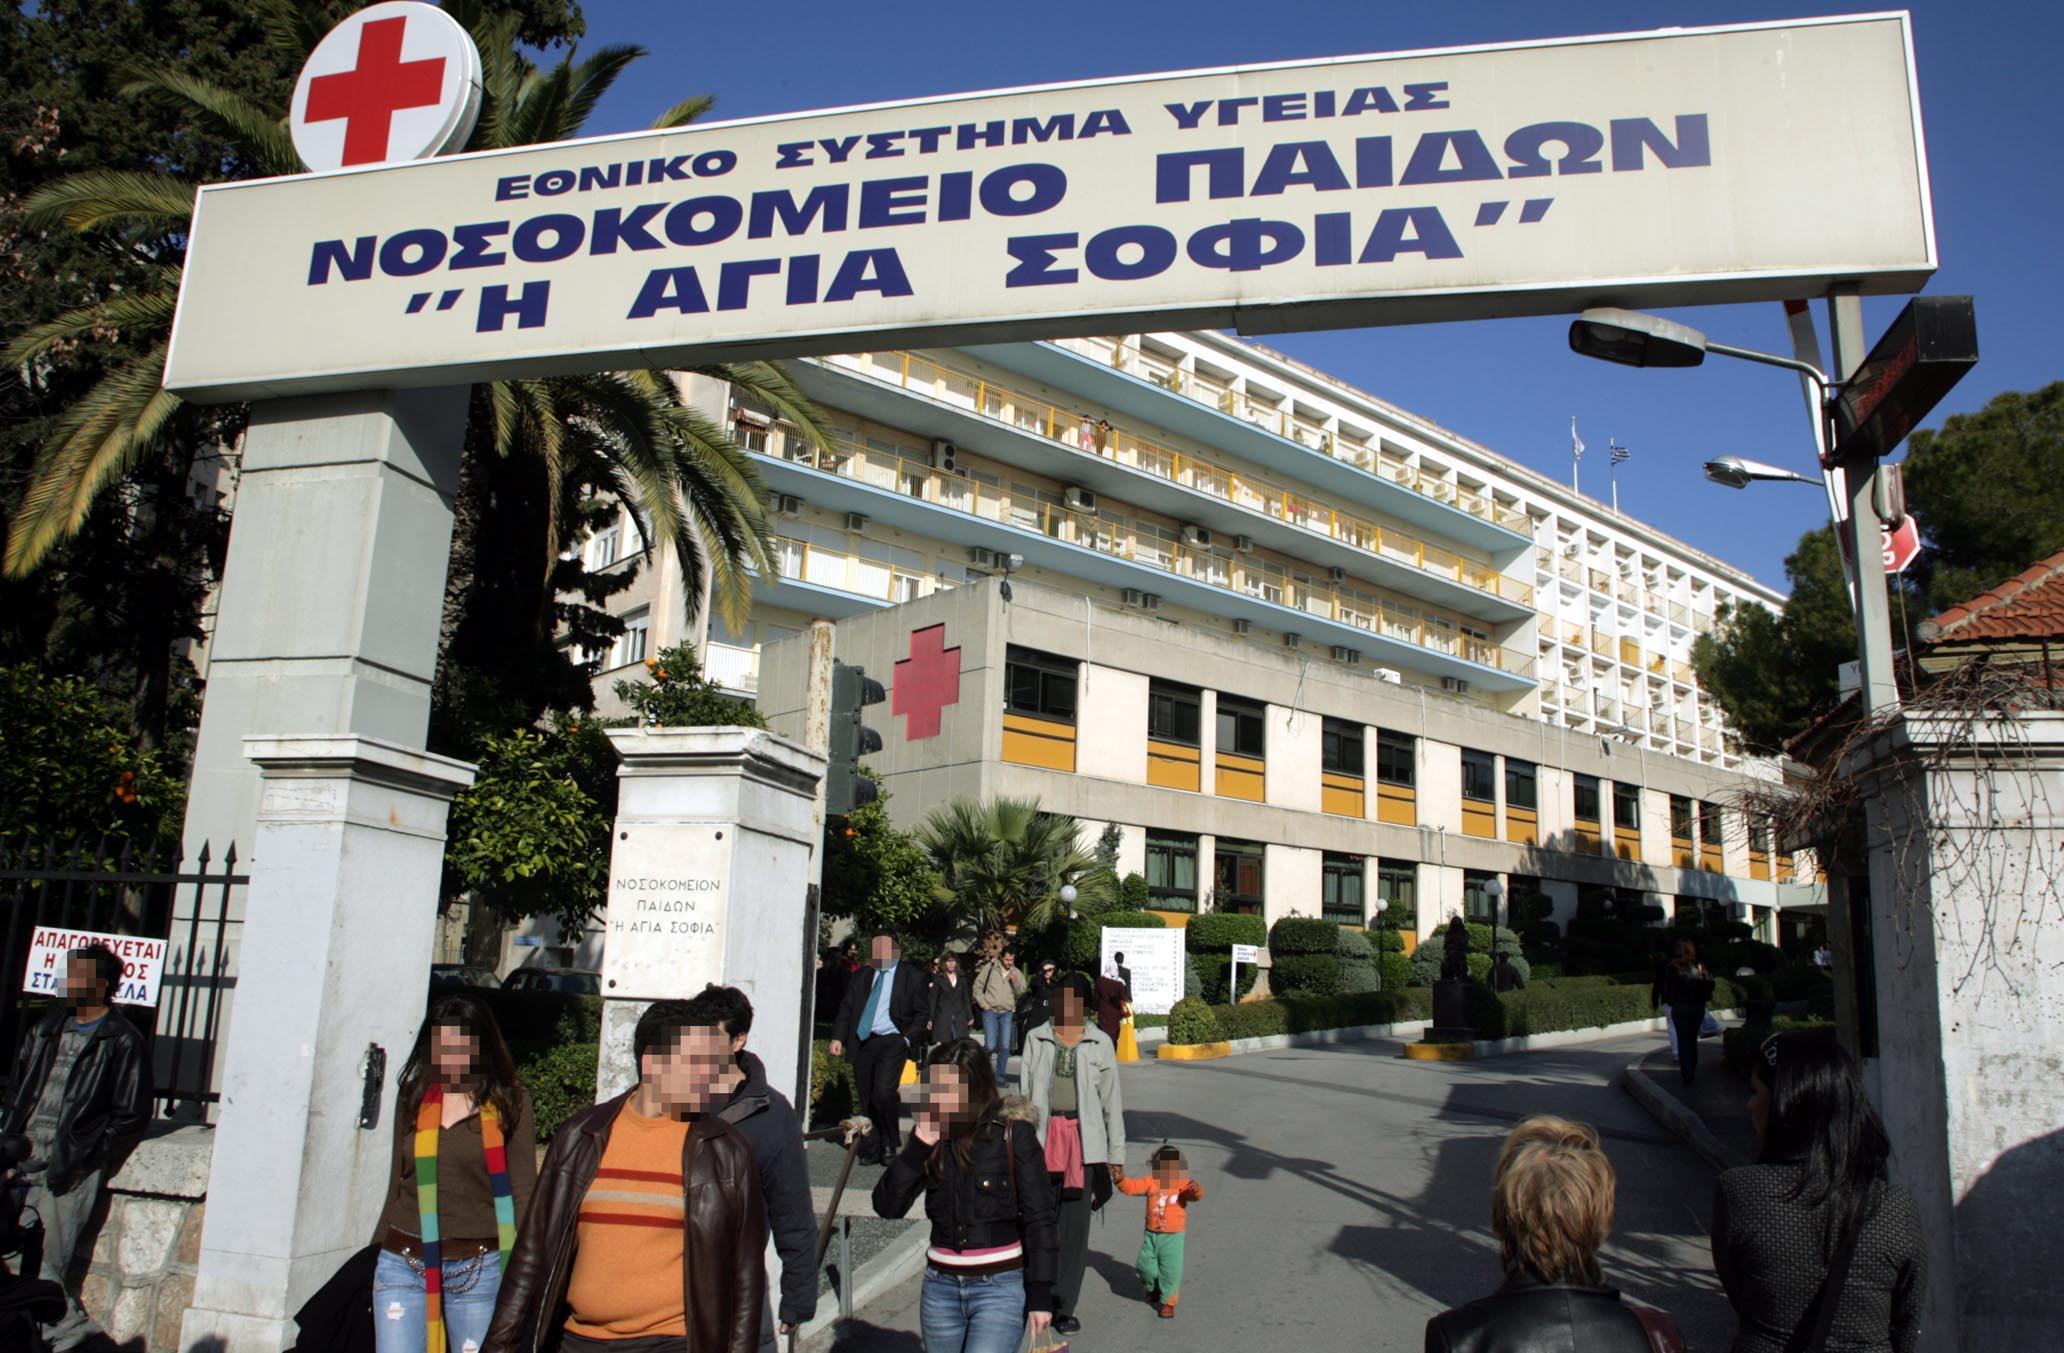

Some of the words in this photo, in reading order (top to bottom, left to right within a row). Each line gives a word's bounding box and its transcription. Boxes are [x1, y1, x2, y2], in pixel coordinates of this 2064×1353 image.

[495, 149, 737, 200] ΕΘΝΙΚΟ
[776, 108, 1131, 167] ΣΥΣΤΗΜΑ
[1166, 81, 1450, 128] ΥΓΕΙΑΣ
[307, 162, 1067, 285] ΝΟΣΟΚΟΜΕΙΟ
[1156, 112, 1711, 202] ΠΑΙΔΩΝ
[626, 246, 914, 319] ΑΓΙΑ
[616, 878, 721, 892] ΝΟΣΟΚΟΜΕΙΟΝ
[637, 899, 696, 912] ΠΑΙΔΩΝ
[630, 920, 662, 933] ΑΓΙΑ
[44, 953, 56, 968] Η
